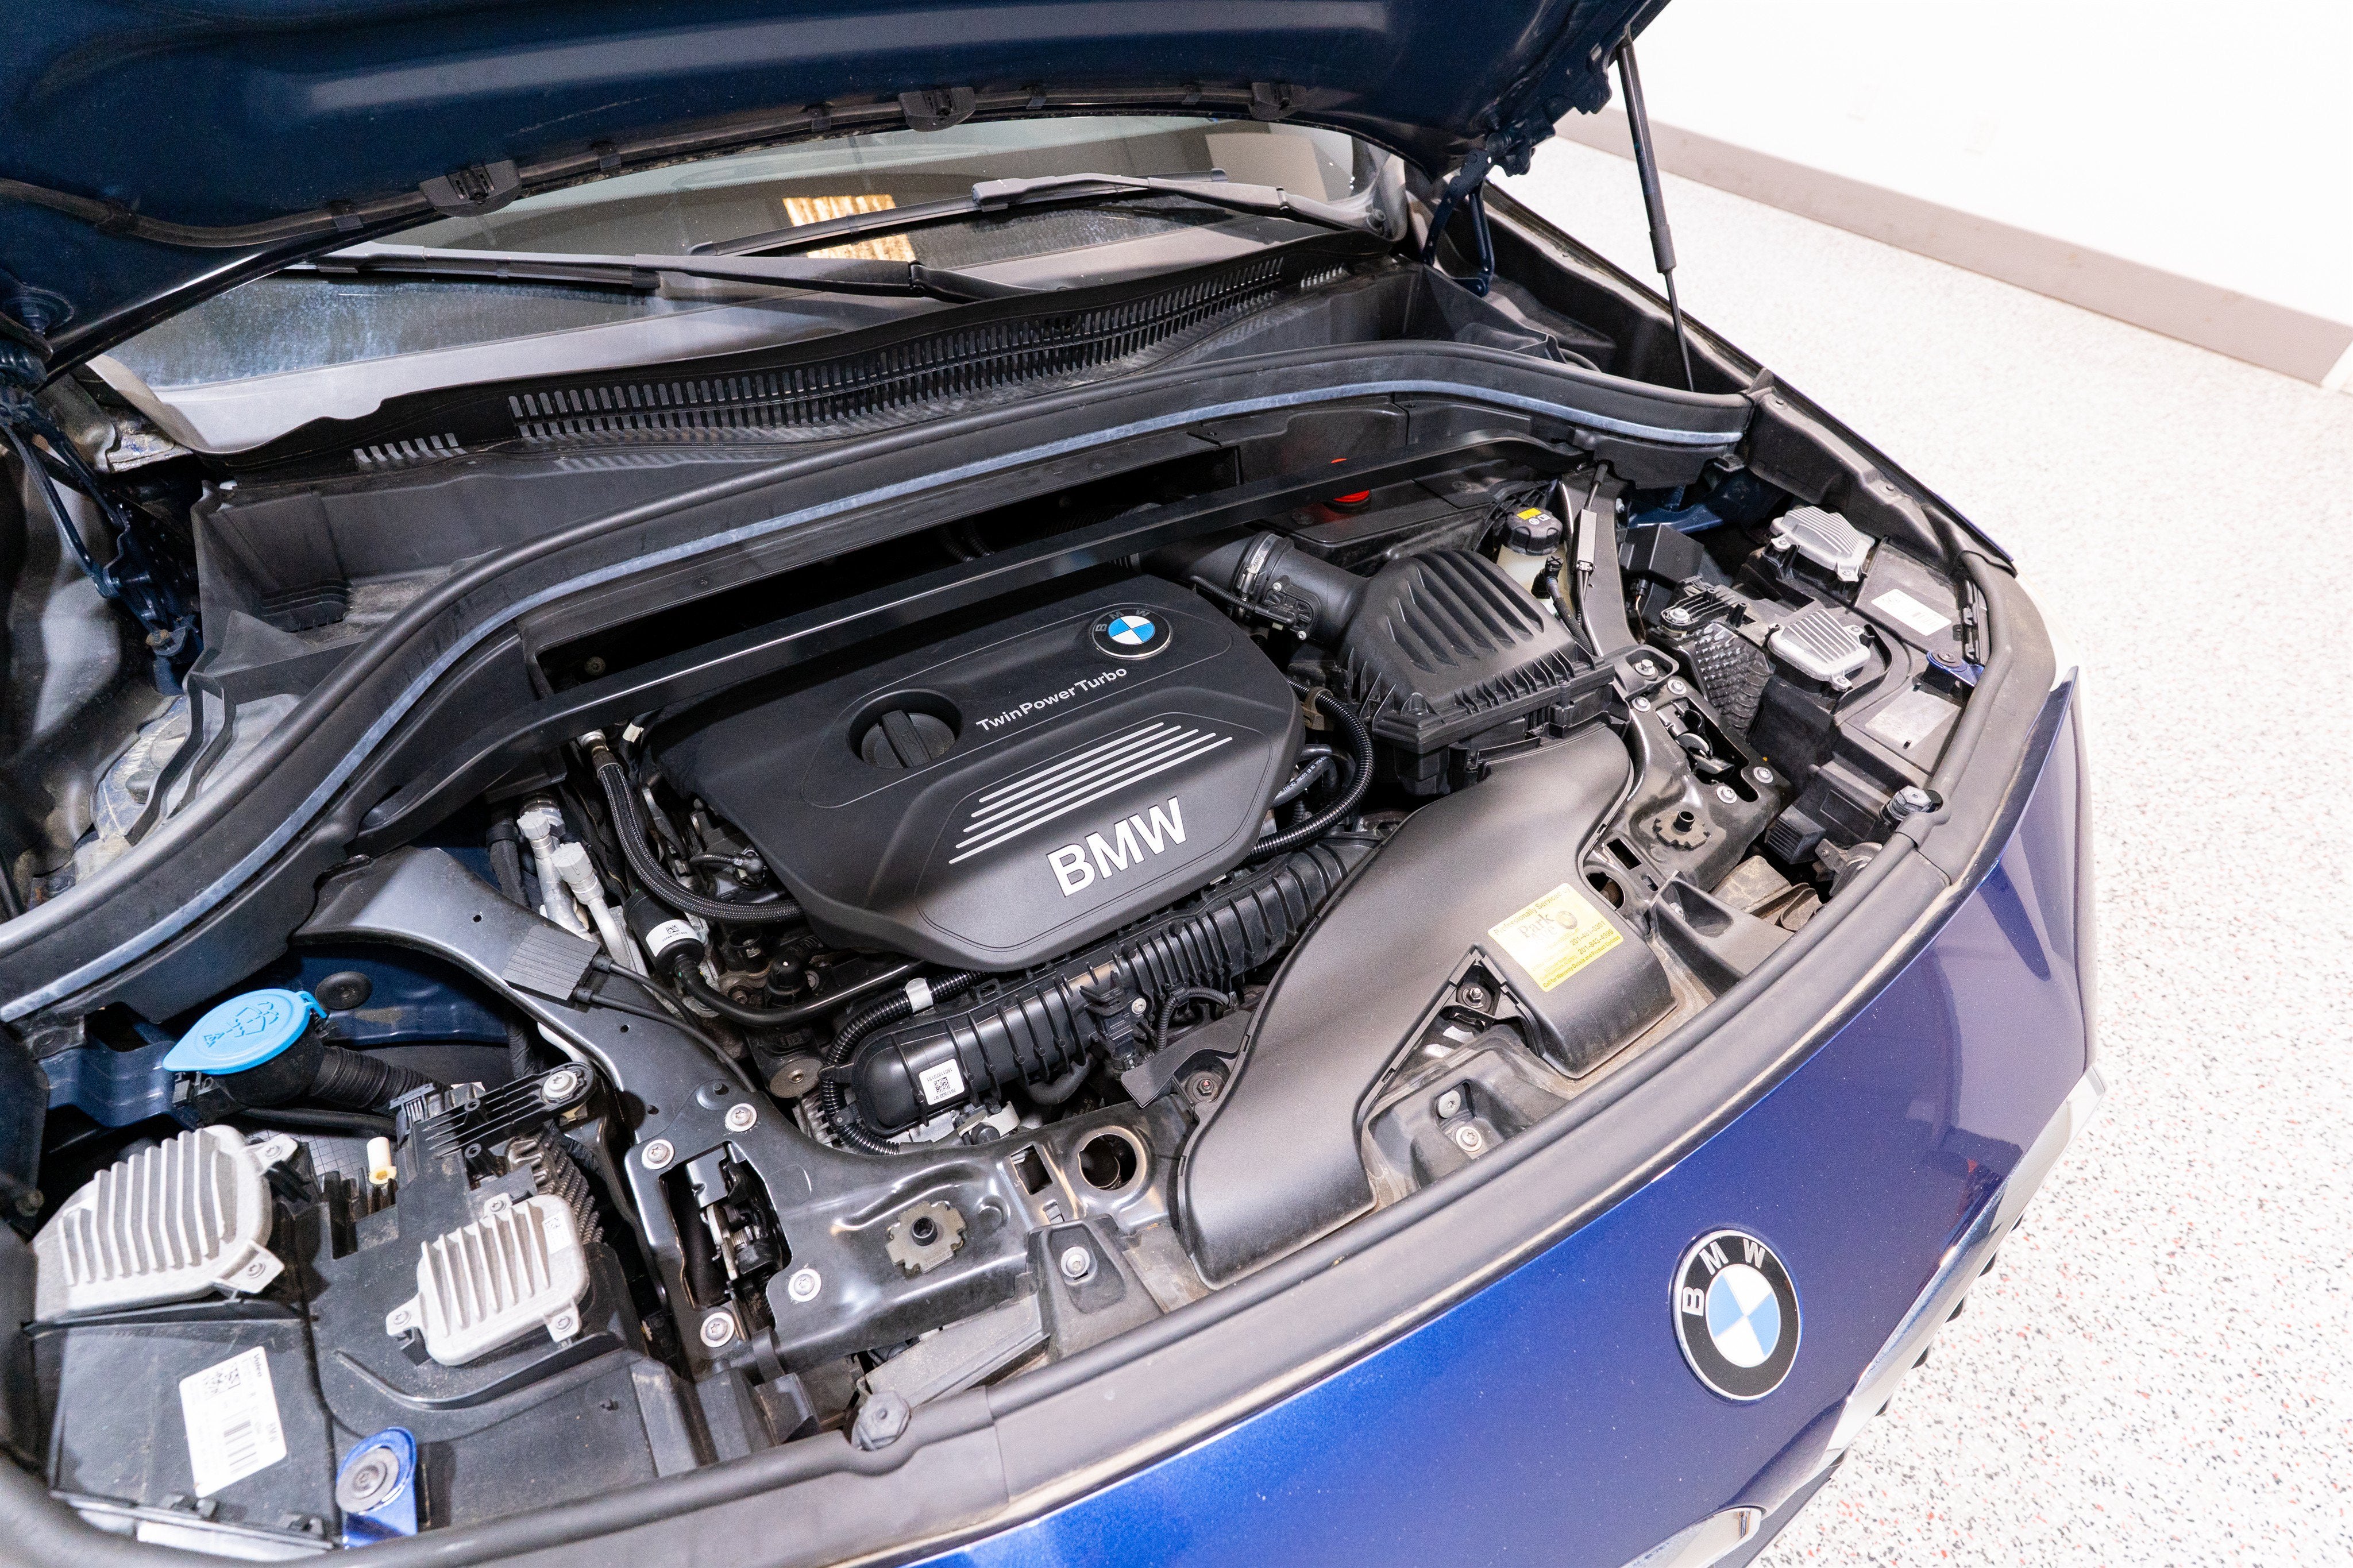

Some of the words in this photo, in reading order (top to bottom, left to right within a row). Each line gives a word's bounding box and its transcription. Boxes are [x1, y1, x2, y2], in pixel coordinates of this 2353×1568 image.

[1096, 609, 1150, 632] BMW
[975, 687, 1075, 731] TwinPower
[1074, 669, 1127, 692] Turbo
[1046, 795, 1186, 897] BMW
[1494, 907, 1537, 936] Professionally
[1536, 891, 1562, 909] Serviced
[1517, 912, 1554, 939] Park
[1570, 921, 1606, 946] 201-481-0301
[1578, 929, 1614, 955] 201-843-4999
[1542, 979, 1551, 988] Call
[1556, 965, 1573, 980] Warranty
[1572, 957, 1586, 968] Details
[1584, 952, 1592, 960] and
[1591, 944, 1606, 956] Product
[1606, 935, 1621, 948] Updates
[1682, 1238, 1765, 1316] BMW
[253, 1353, 263, 1377] Valeo
